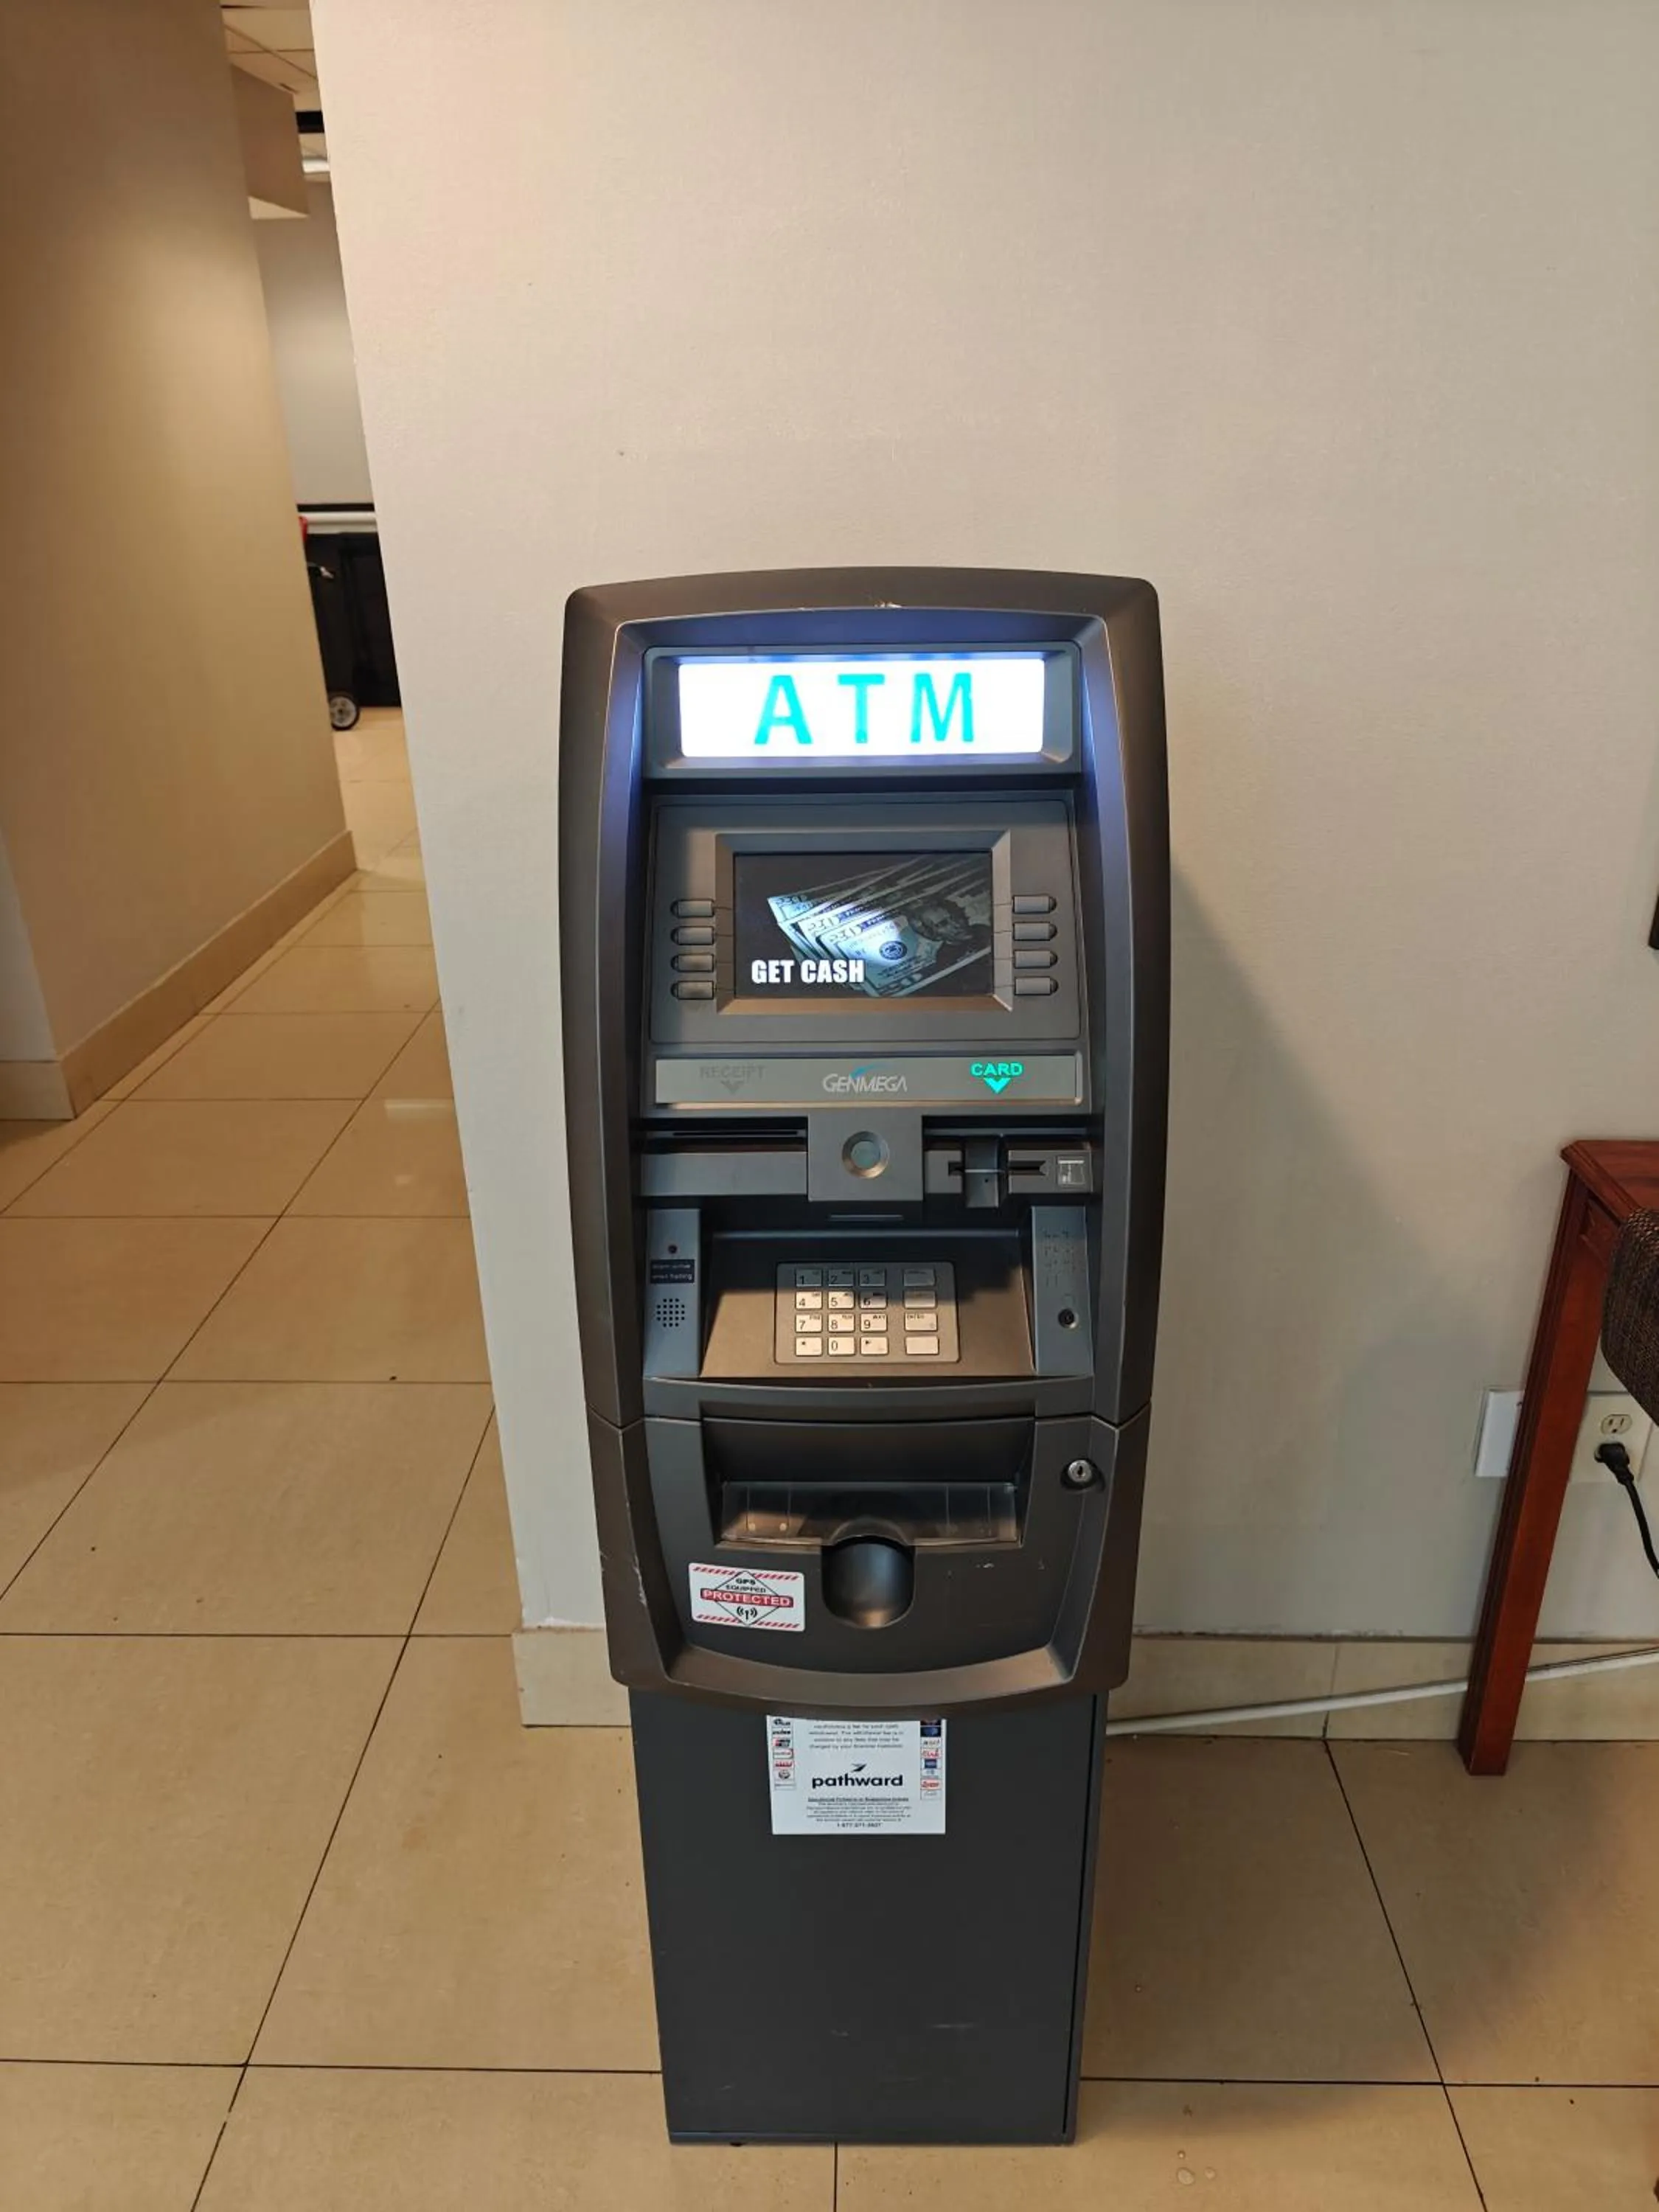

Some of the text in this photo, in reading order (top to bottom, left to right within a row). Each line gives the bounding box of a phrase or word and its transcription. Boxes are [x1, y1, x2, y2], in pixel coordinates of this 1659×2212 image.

[754, 672, 975, 745] ATM
[751, 959, 865, 984] GET CASH
[699, 1065, 765, 1081] RECEIPT
[970, 1062, 1024, 1077] CARD
[822, 1073, 908, 1093] GENMEGA
[799, 1298, 806, 1307] 4
[830, 1297, 838, 1307] 5
[799, 1320, 806, 1330] 7
[830, 1319, 838, 1329] 8
[863, 1319, 871, 1329] 9
[703, 1590, 790, 1606] PROTECTED
[812, 1773, 903, 1789] pathward
